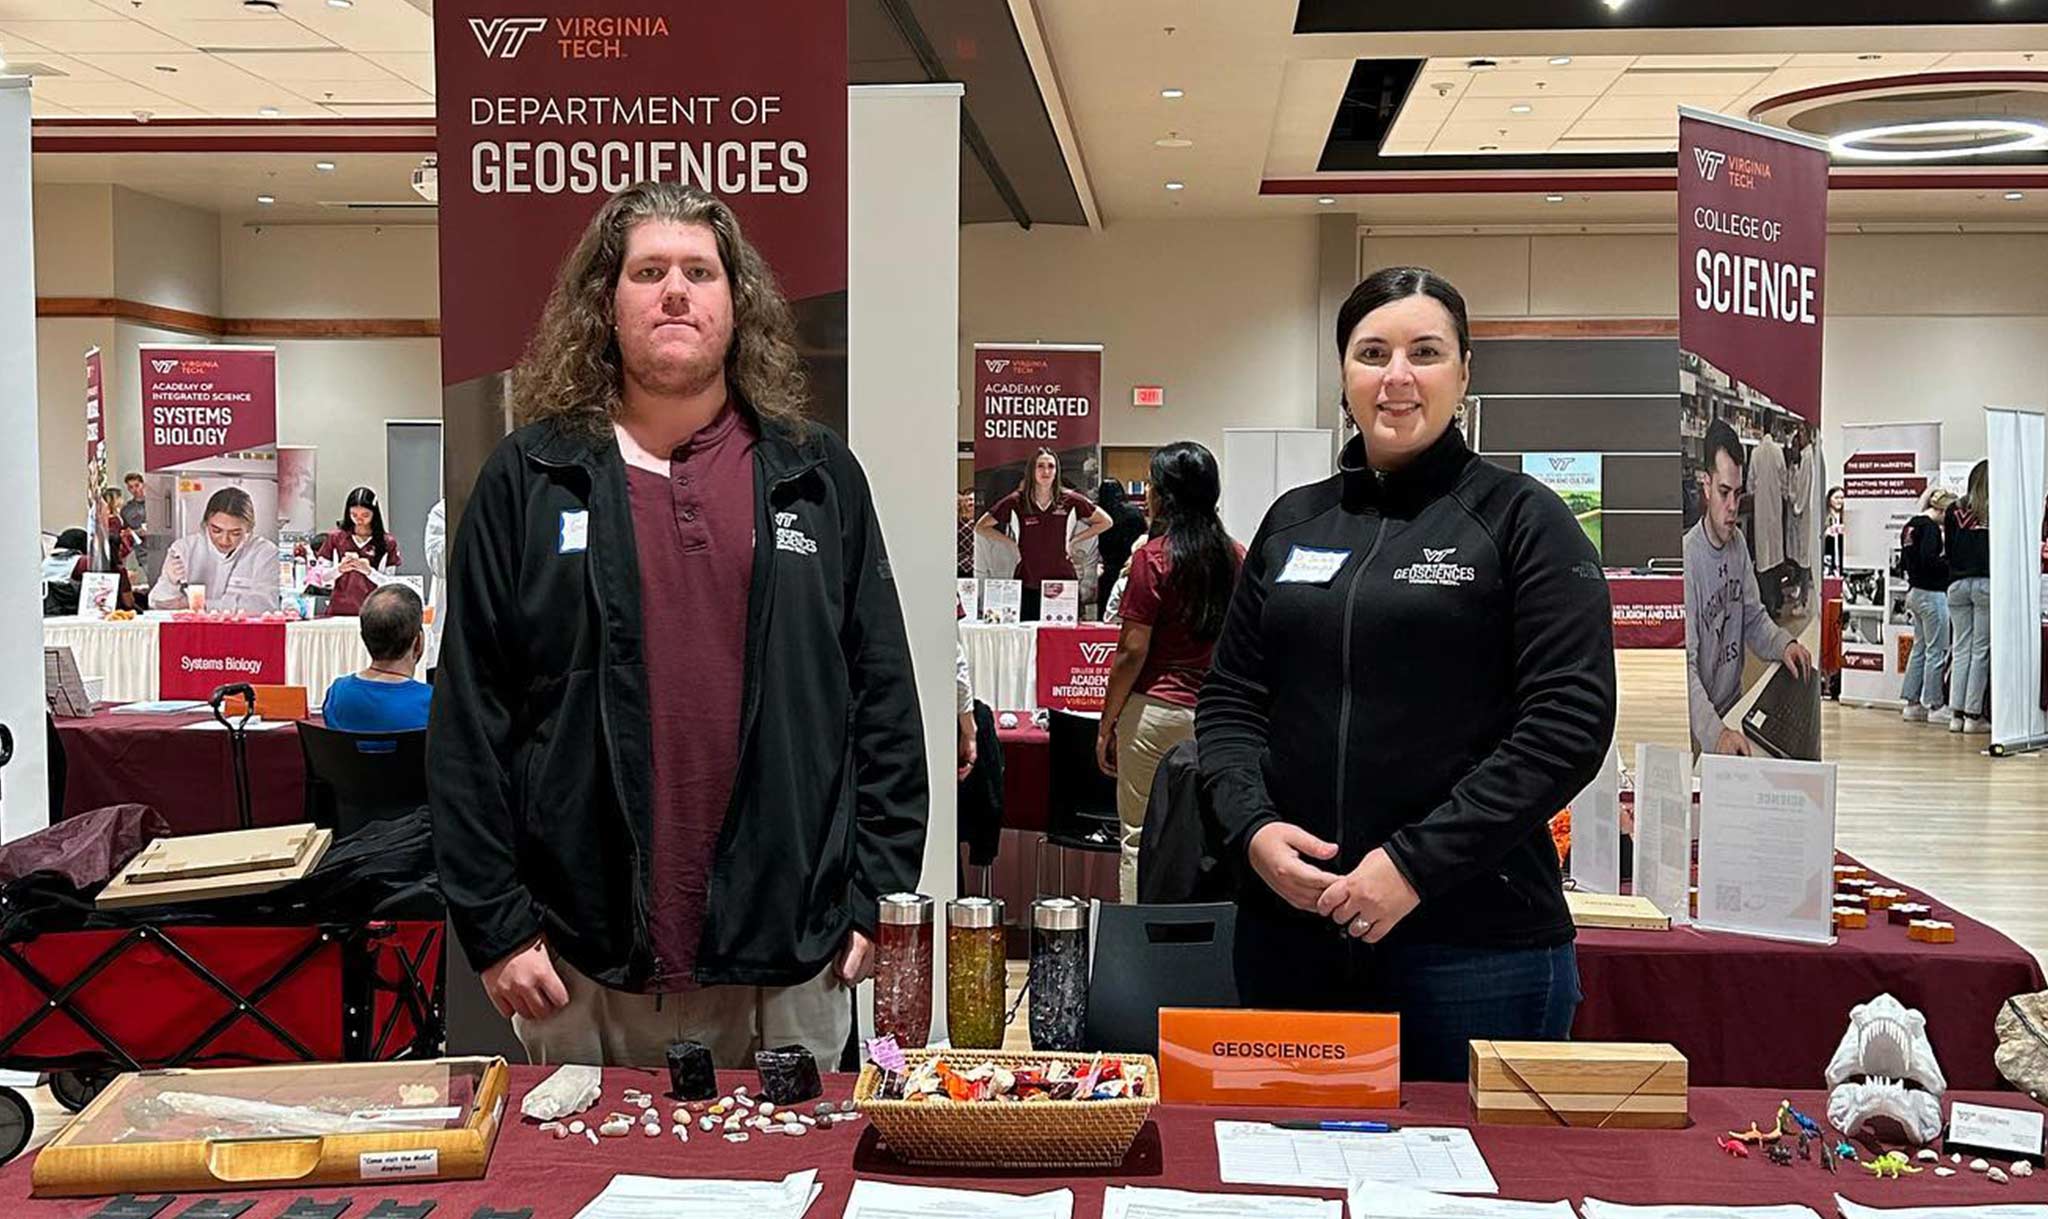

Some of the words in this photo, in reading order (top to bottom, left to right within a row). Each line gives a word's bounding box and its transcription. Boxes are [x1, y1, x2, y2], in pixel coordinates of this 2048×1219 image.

[468, 18, 548, 58] VT
[556, 17, 669, 36] VIRGINIA
[559, 40, 621, 58] TECH
[470, 97, 720, 125] DEPARTMENT
[731, 96, 781, 124] OF
[471, 140, 809, 195] GEOSCIENCES
[1692, 147, 1726, 181] VT
[1728, 155, 1772, 178] VIRGINIA
[1694, 206, 1760, 239] COLLEGE
[1761, 220, 1782, 242] OF
[1695, 248, 1817, 325] SCIENCE
[151, 359, 179, 374] VT
[984, 359, 1010, 374] VT
[152, 383, 199, 391] ACADEMY
[201, 383, 213, 391] OF
[984, 383, 1042, 394] ACADEMY
[1044, 384, 1062, 395] OF
[152, 392, 210, 401] INTEGRATED
[212, 393, 251, 402] SCIENCE
[985, 396, 1089, 417] INTEGRATED
[153, 407, 232, 426] SYSTEMS
[154, 427, 228, 446] BIOLOGY
[984, 418, 1058, 439] SCIENCE
[1393, 566, 1475, 581] GEOSCIENCES
[1079, 642, 1119, 664] VT
[181, 656, 223, 672] Systems
[225, 657, 262, 674] Biology
[1070, 675, 1110, 686] ACADEM
[1052, 686, 1106, 697] INTEGRATED
[1212, 1041, 1346, 1060] GEOSCIENCES
